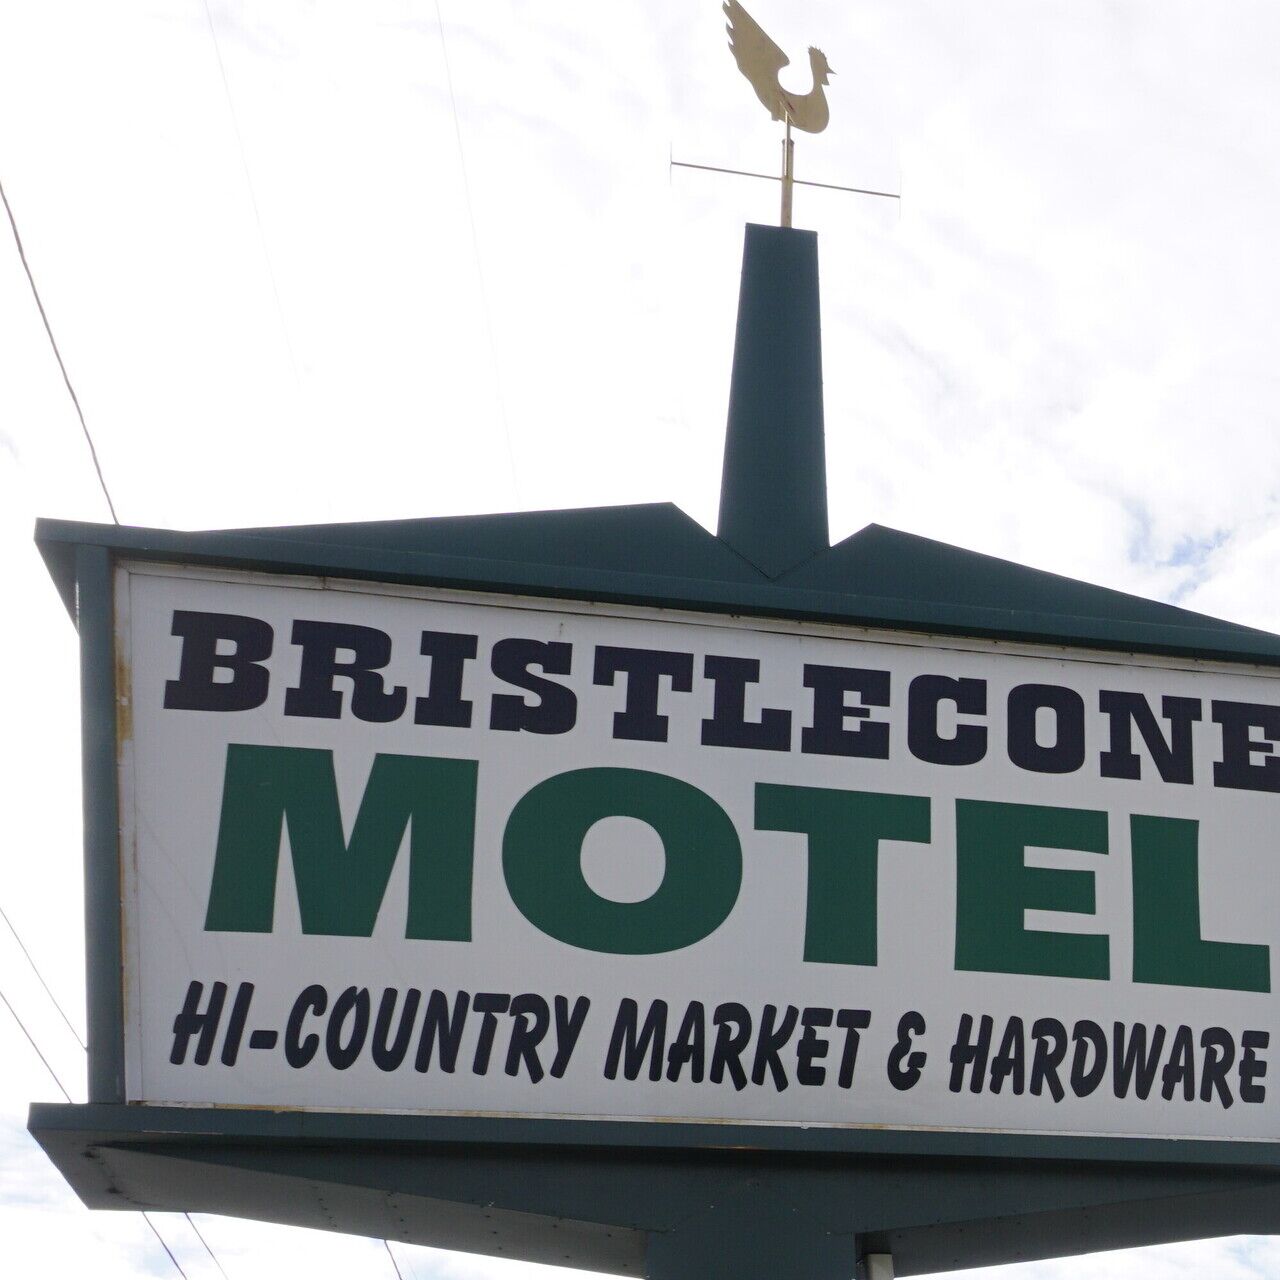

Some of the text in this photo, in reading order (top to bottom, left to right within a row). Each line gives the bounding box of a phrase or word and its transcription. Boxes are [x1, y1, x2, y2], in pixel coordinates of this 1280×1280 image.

[203, 743, 1272, 993] MOTEL
[169, 980, 1270, 1110] HI-COUNTRY MARKET & HARDWARE
